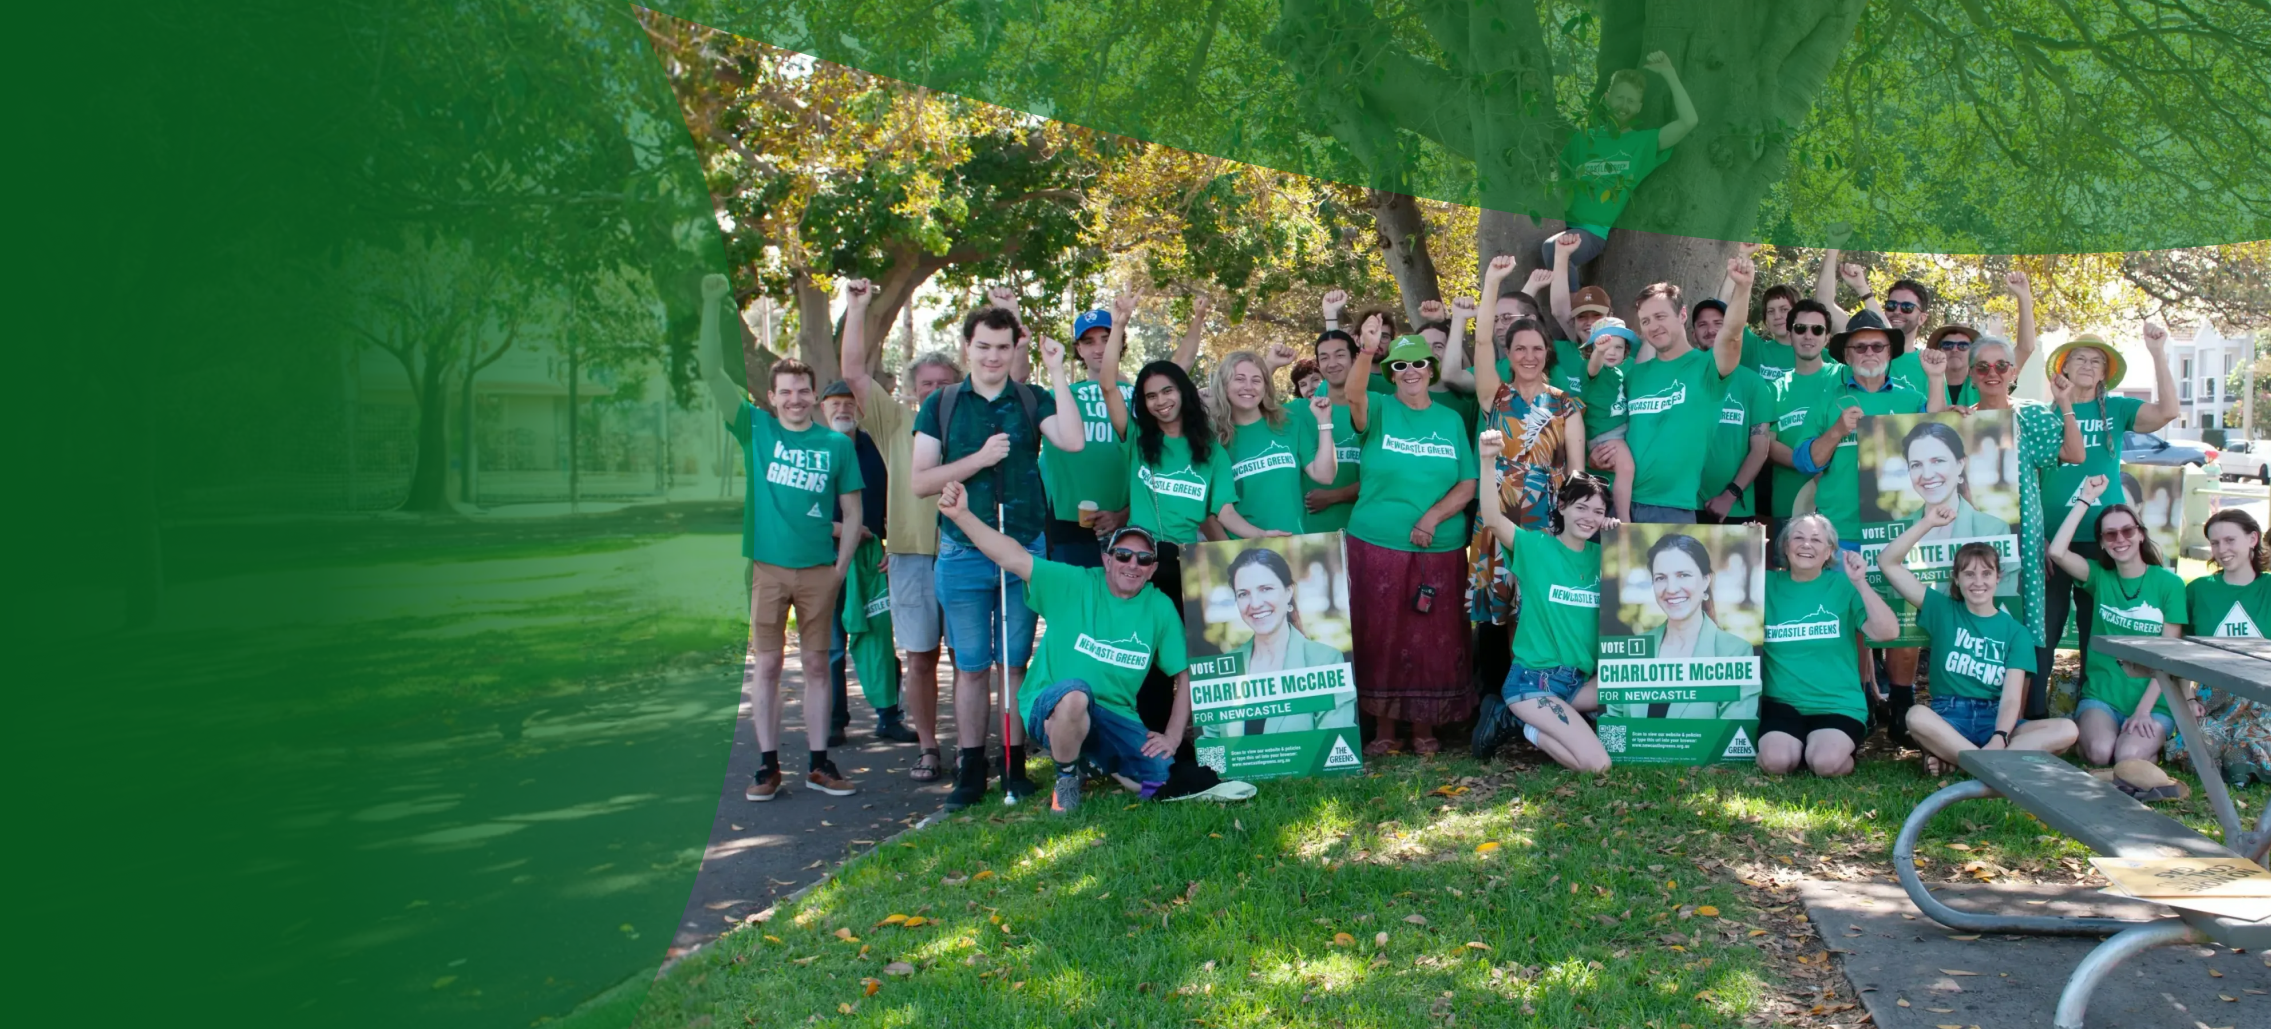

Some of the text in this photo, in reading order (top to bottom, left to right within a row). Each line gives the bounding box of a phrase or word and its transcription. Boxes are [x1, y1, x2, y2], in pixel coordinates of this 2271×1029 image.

[1078, 384, 1135, 402] STNG
[1086, 402, 1108, 418] LO
[1084, 421, 1112, 442] VOI
[2076, 417, 2114, 432] TURE
[1386, 438, 1454, 457] NEWCASTLE GREENS
[2083, 434, 2102, 448] LL
[1267, 455, 1294, 467] GREENS
[766, 461, 828, 493] GREENS
[1172, 482, 1202, 498] GREENS
[1862, 527, 1886, 540] VOTE
[1863, 540, 2012, 566] CHLOTTE MBE
[1808, 624, 1837, 636] GREENS
[2134, 621, 2162, 634] GREENS
[2224, 622, 2248, 636] THE
[1601, 642, 1624, 654] VOTE
[1116, 652, 1146, 667] GREENS
[1190, 661, 1215, 676] VOTE
[1600, 662, 1753, 682] CHARLOTTE McCABE
[1944, 651, 2006, 686] GREENS
[1192, 668, 1346, 704] CHARLOTTE McCABE
[1600, 690, 1696, 700] FOR NEWCASTLE
[1194, 702, 1292, 724] FOR NEWCASTLE
[1336, 746, 1347, 754] THE
[1330, 754, 1354, 764] GREENS
